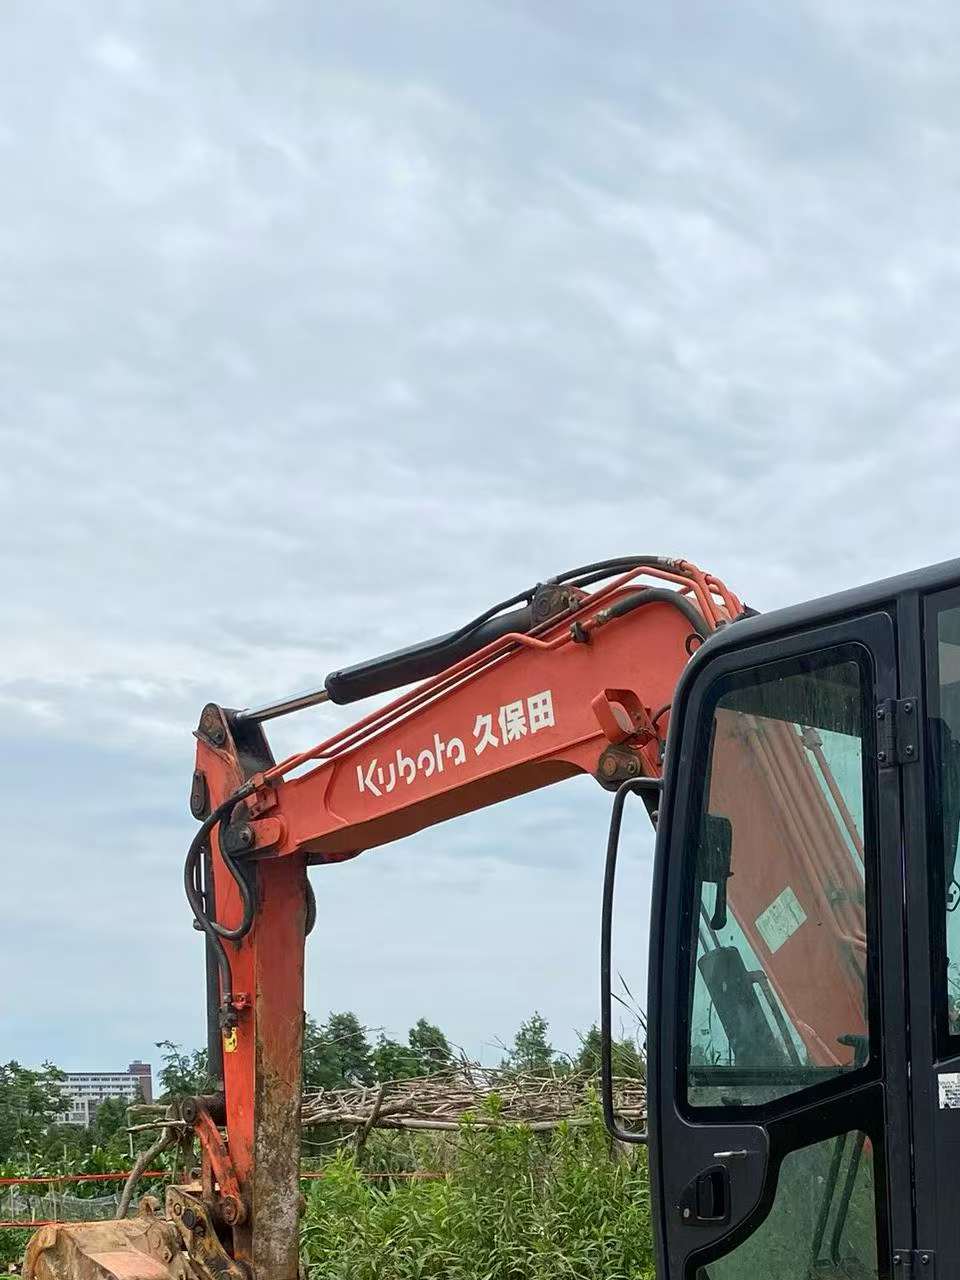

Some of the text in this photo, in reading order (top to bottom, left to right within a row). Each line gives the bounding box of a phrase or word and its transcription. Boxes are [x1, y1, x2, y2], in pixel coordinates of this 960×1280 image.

[356, 690, 556, 797] Kubota 久保田
